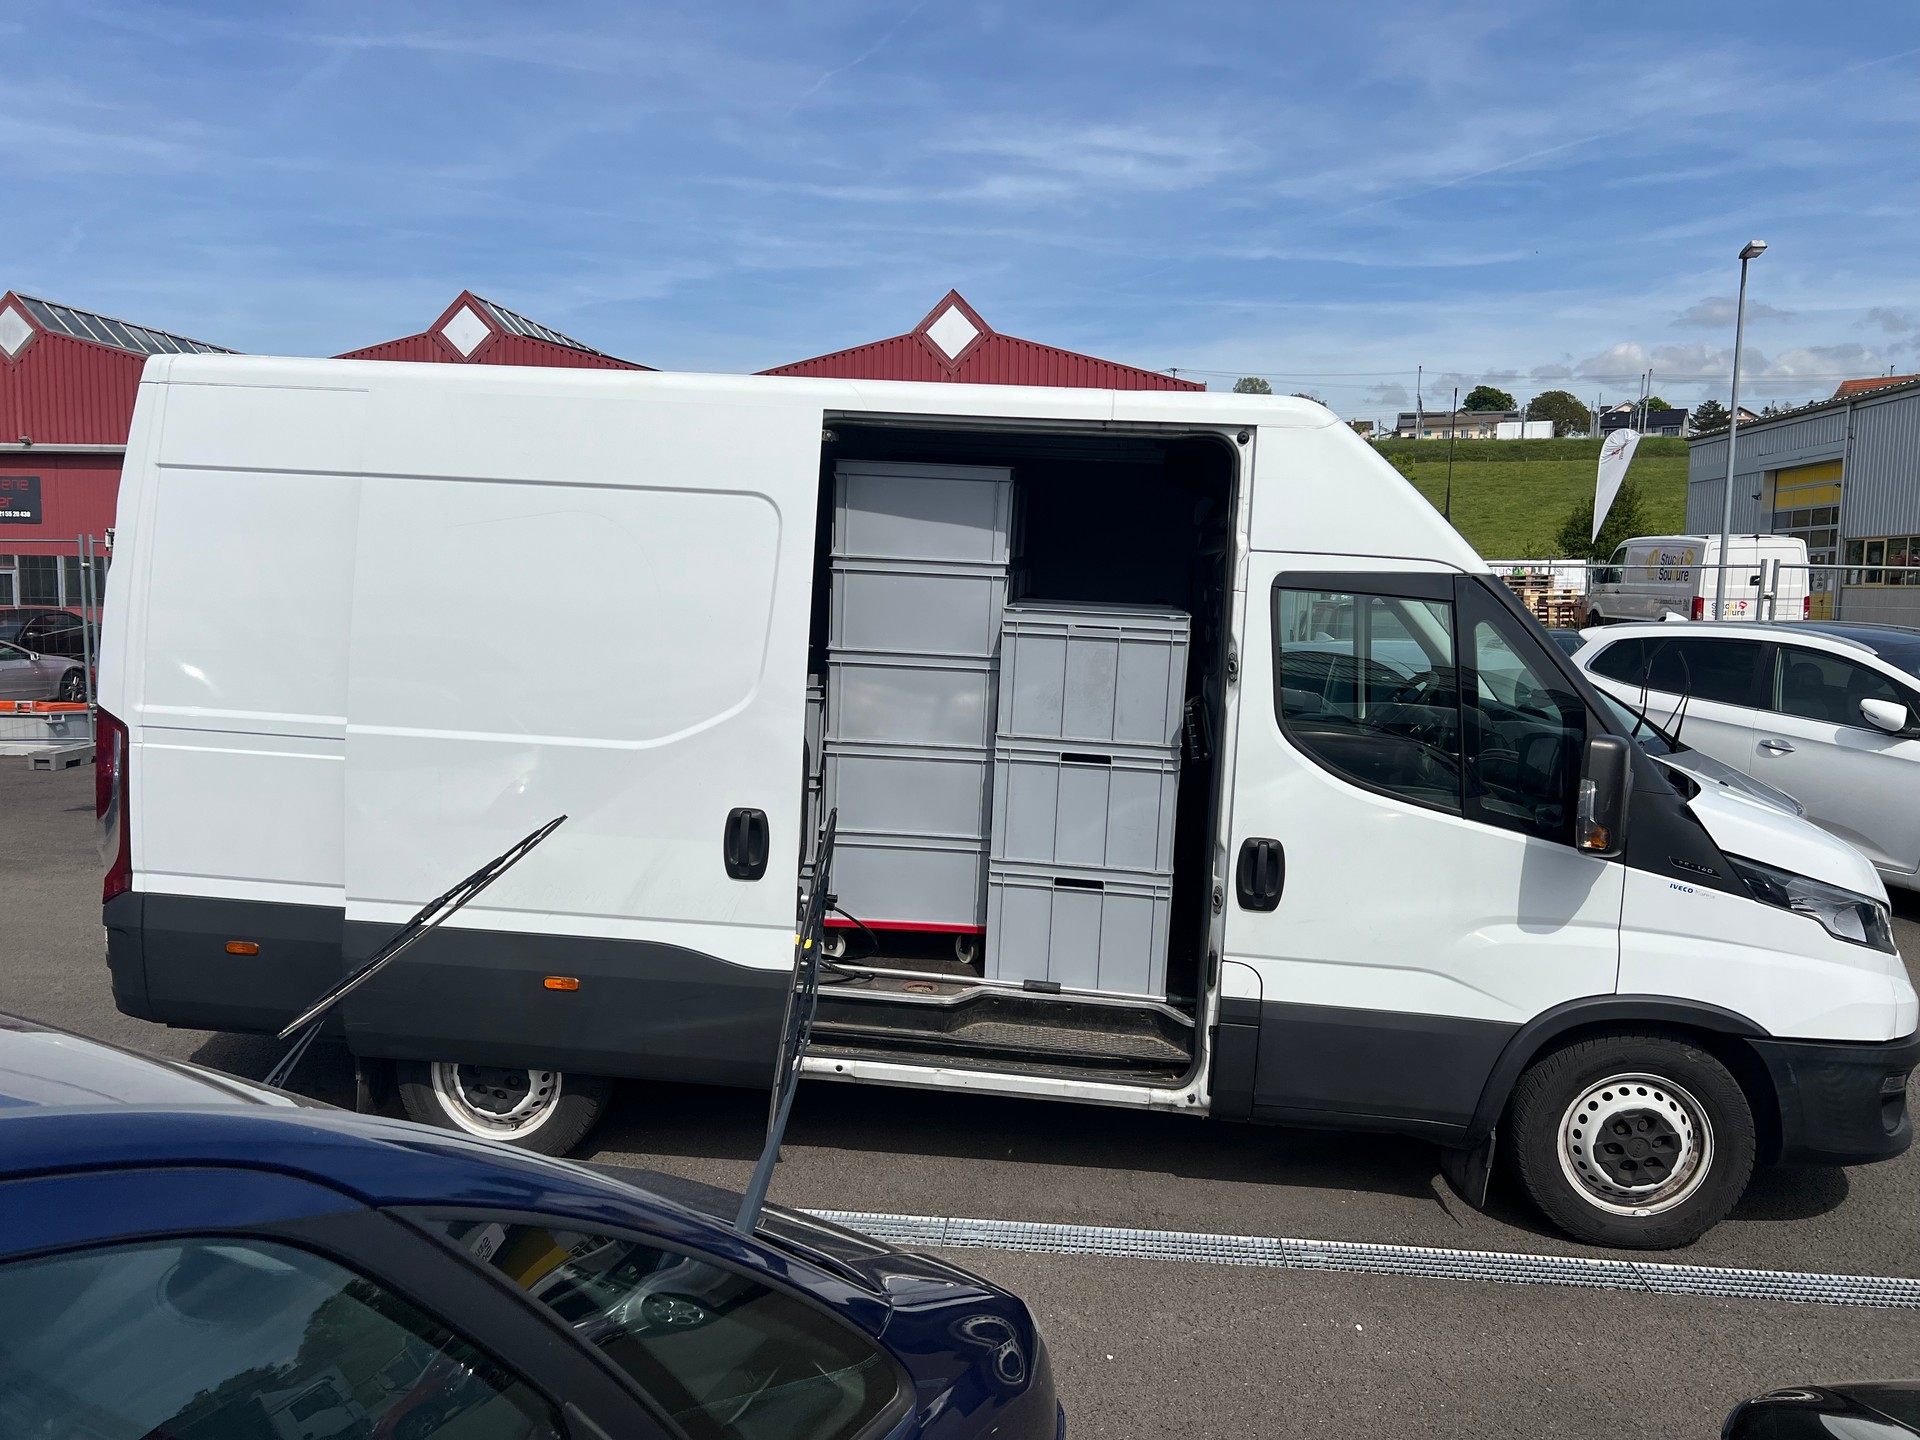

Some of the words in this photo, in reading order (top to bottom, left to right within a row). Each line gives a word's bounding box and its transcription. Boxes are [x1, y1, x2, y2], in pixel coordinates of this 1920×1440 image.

[1711, 602, 1738, 610] Scki
[1711, 609, 1746, 617] Sudure
[1669, 883, 1694, 894] IVECO
